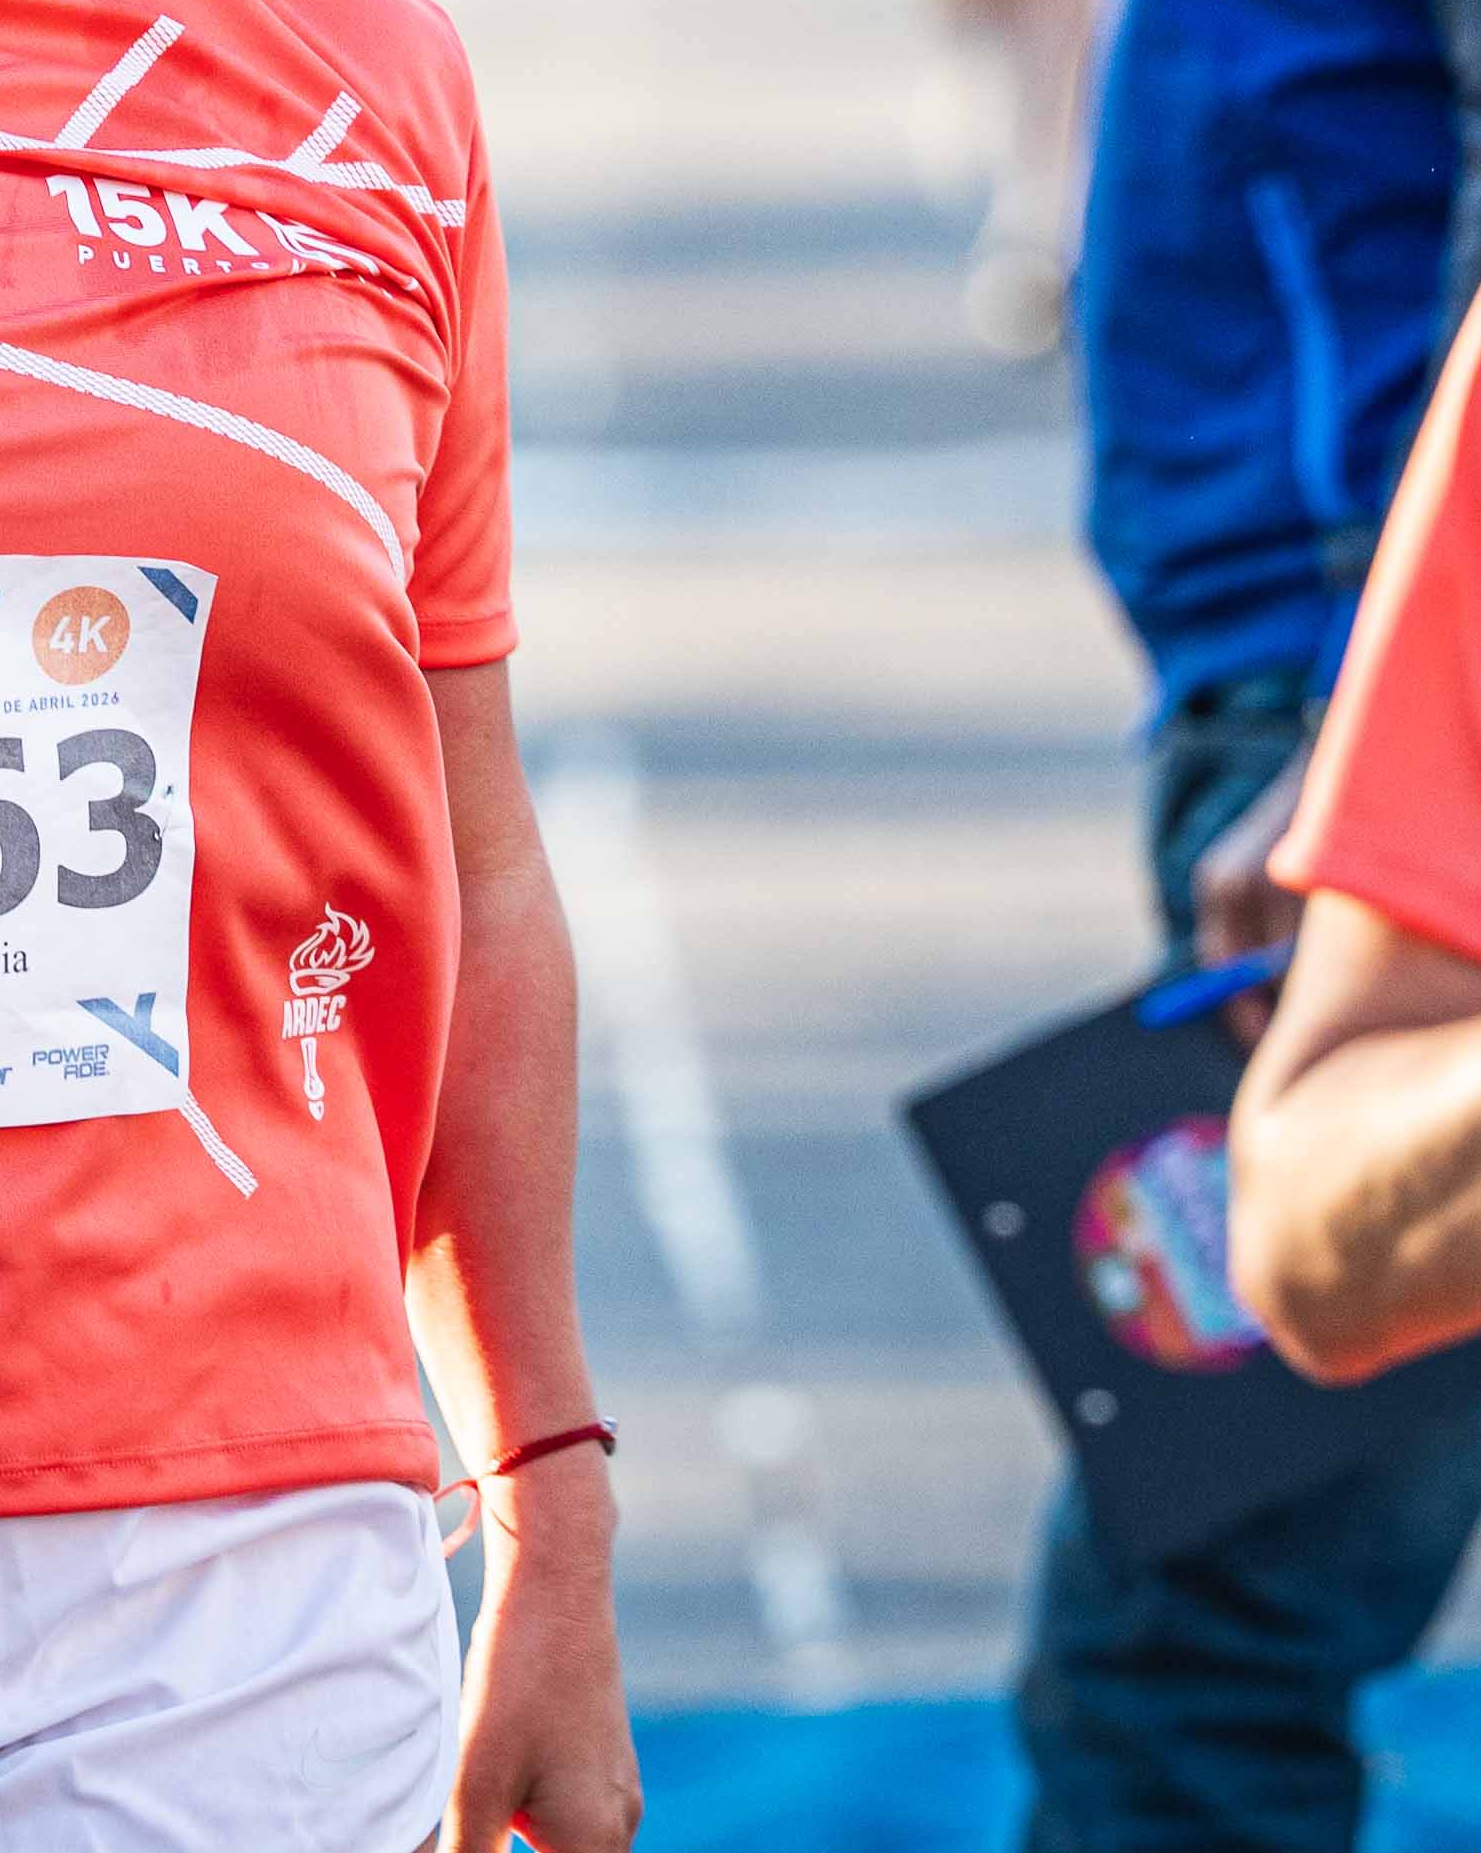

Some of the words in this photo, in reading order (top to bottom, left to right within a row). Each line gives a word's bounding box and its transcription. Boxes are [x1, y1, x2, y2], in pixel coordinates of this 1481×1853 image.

[45, 173, 260, 256] 15K
[49, 614, 110, 656] 4K
[4, 699, 22, 714] DE
[29, 695, 75, 712] ABRIL
[81, 691, 120, 708] 2026
[282, 995, 346, 1039] ARDEC
[32, 1044, 109, 1066] POWER
